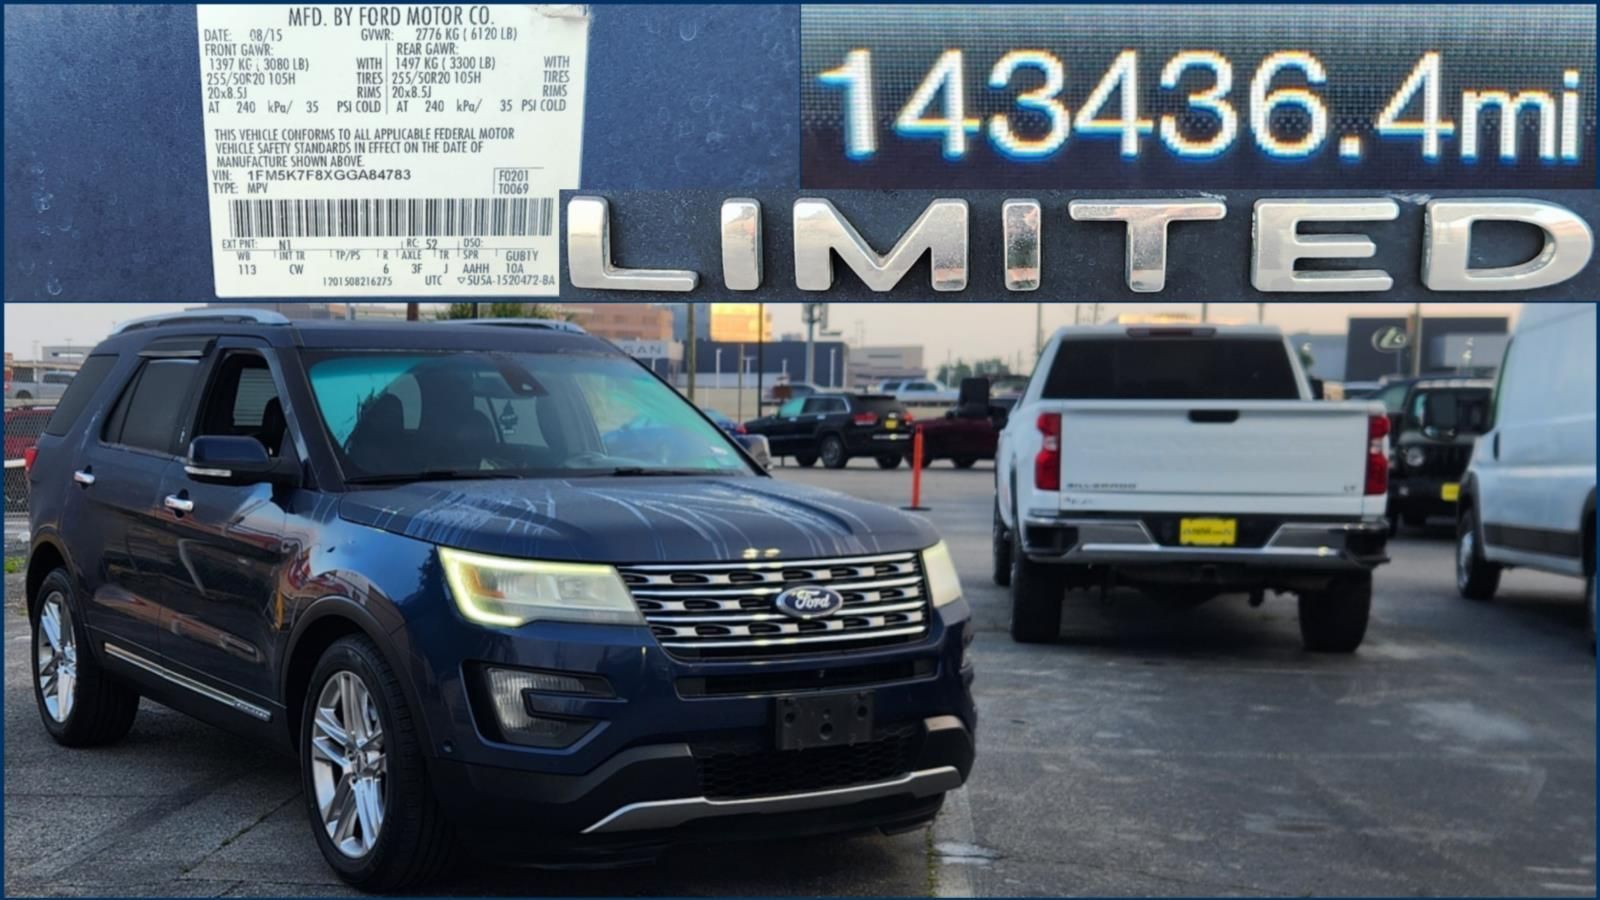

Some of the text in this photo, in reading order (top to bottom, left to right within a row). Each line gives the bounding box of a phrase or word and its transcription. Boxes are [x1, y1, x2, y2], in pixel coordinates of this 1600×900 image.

[288, 5, 495, 26] MFD. BY FORD MOTOR CO.
[204, 28, 283, 42] DATE: 08/15
[360, 28, 394, 41] GVWR:
[415, 27, 442, 41] 2776
[445, 27, 460, 41] KG
[471, 27, 498, 41] 6120
[500, 27, 518, 42] LB)
[204, 43, 274, 56] FRONT GAWR:
[396, 42, 460, 55] REAR GAWR:
[209, 57, 235, 71] 1397
[238, 57, 252, 71] KG
[263, 57, 290, 71] 3080
[293, 57, 310, 72] LB)
[356, 57, 383, 70] WITH
[395, 57, 421, 70] 1497
[424, 57, 439, 70] KG
[449, 56, 476, 70] 3300
[479, 57, 496, 71] LB)
[544, 56, 570, 69] WITH
[206, 72, 296, 86] 255/50R20 105H
[356, 72, 384, 85] TIRES
[392, 71, 481, 85] 255/50R20 105H
[544, 70, 570, 83] TIRES
[207, 86, 247, 100] 20x8.5J
[356, 86, 382, 99] RIMS
[392, 86, 432, 99] 20x8.5J
[542, 85, 568, 97] RIMS
[208, 101, 220, 113] AT
[236, 101, 256, 113] 240
[306, 101, 319, 113] 35
[336, 101, 352, 113] PSI
[356, 100, 382, 113] COLD
[396, 100, 409, 112] AT
[425, 100, 445, 112] 240
[500, 99, 513, 112] 35
[521, 99, 536, 112] PSI
[540, 99, 567, 112] COLD
[214, 127, 515, 141] THIS VEHICLE CONFORMS TO ALL APPLICABLE FEDERAL MOTOR
[215, 141, 484, 155] VEHICLE SAFETY STANDARDS IN EFFECT ON THE DATE OF
[216, 155, 365, 168] MANUFACTURE SHOWN ABOVE.
[212, 169, 412, 182] VIN: 1FM5K7F8XGGA84783
[213, 182, 268, 195] TYPE: MPV
[222, 239, 291, 250] EXT PNT: N1
[406, 238, 420, 248] RC:
[463, 237, 484, 248] DSO:
[567, 195, 1595, 294] LIMITED
[237, 251, 251, 261] WB
[279, 250, 292, 261] INT
[296, 251, 306, 261] TR
[383, 250, 389, 260] R
[401, 250, 422, 260] AXLE
[439, 250, 450, 260] TR
[463, 249, 479, 260] SPR
[238, 263, 524, 275] 113 CW 6 3F J AAHH 10A
[425, 275, 443, 286] UTC
[794, 589, 832, 610] Ford
